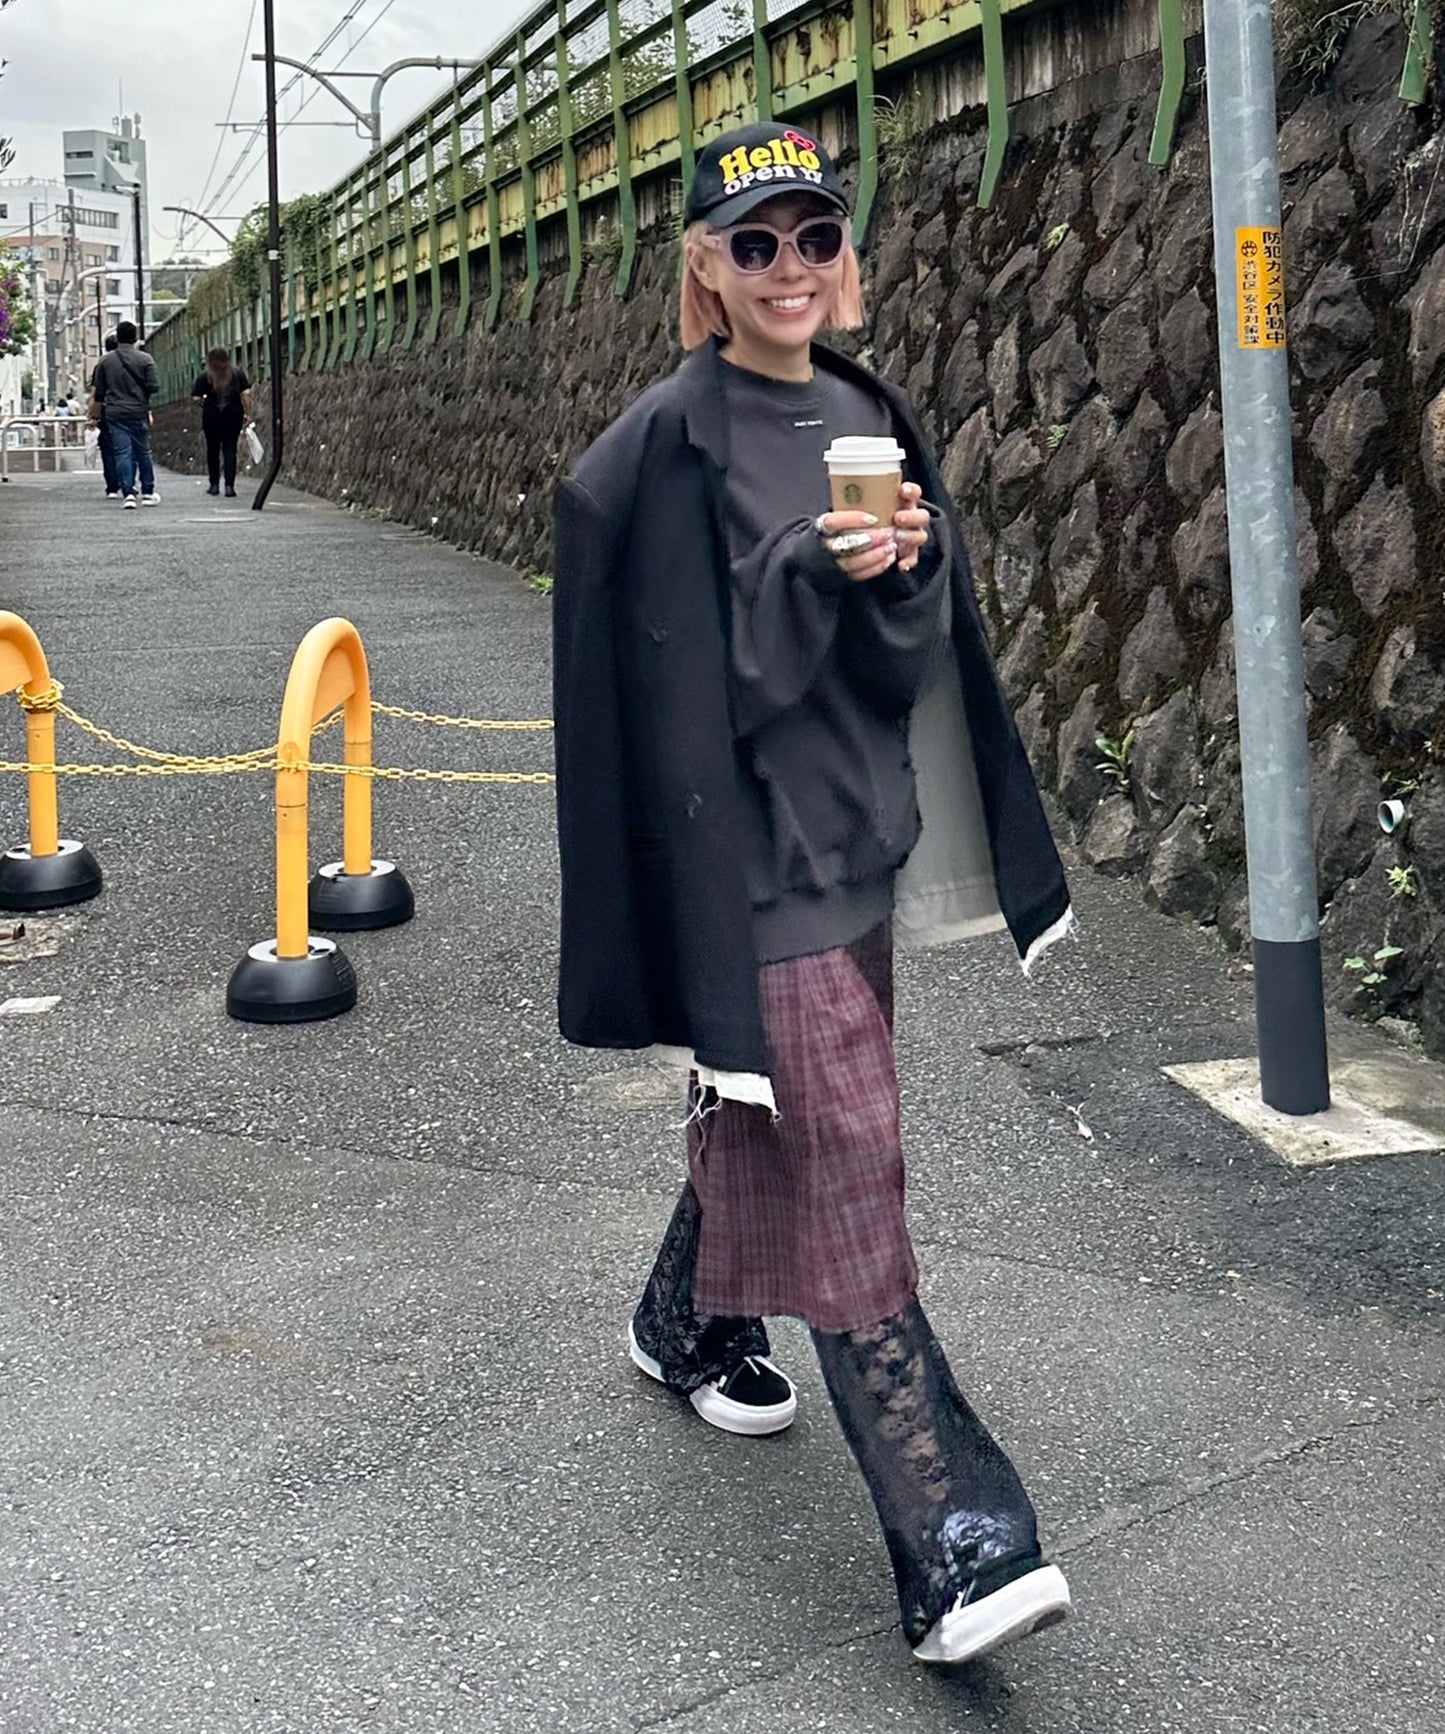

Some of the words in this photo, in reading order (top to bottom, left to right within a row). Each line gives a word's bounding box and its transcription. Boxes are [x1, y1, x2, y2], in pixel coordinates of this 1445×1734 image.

[719, 139, 820, 184] Hello
[1263, 231, 1285, 344] 防犯カメラ作動中
